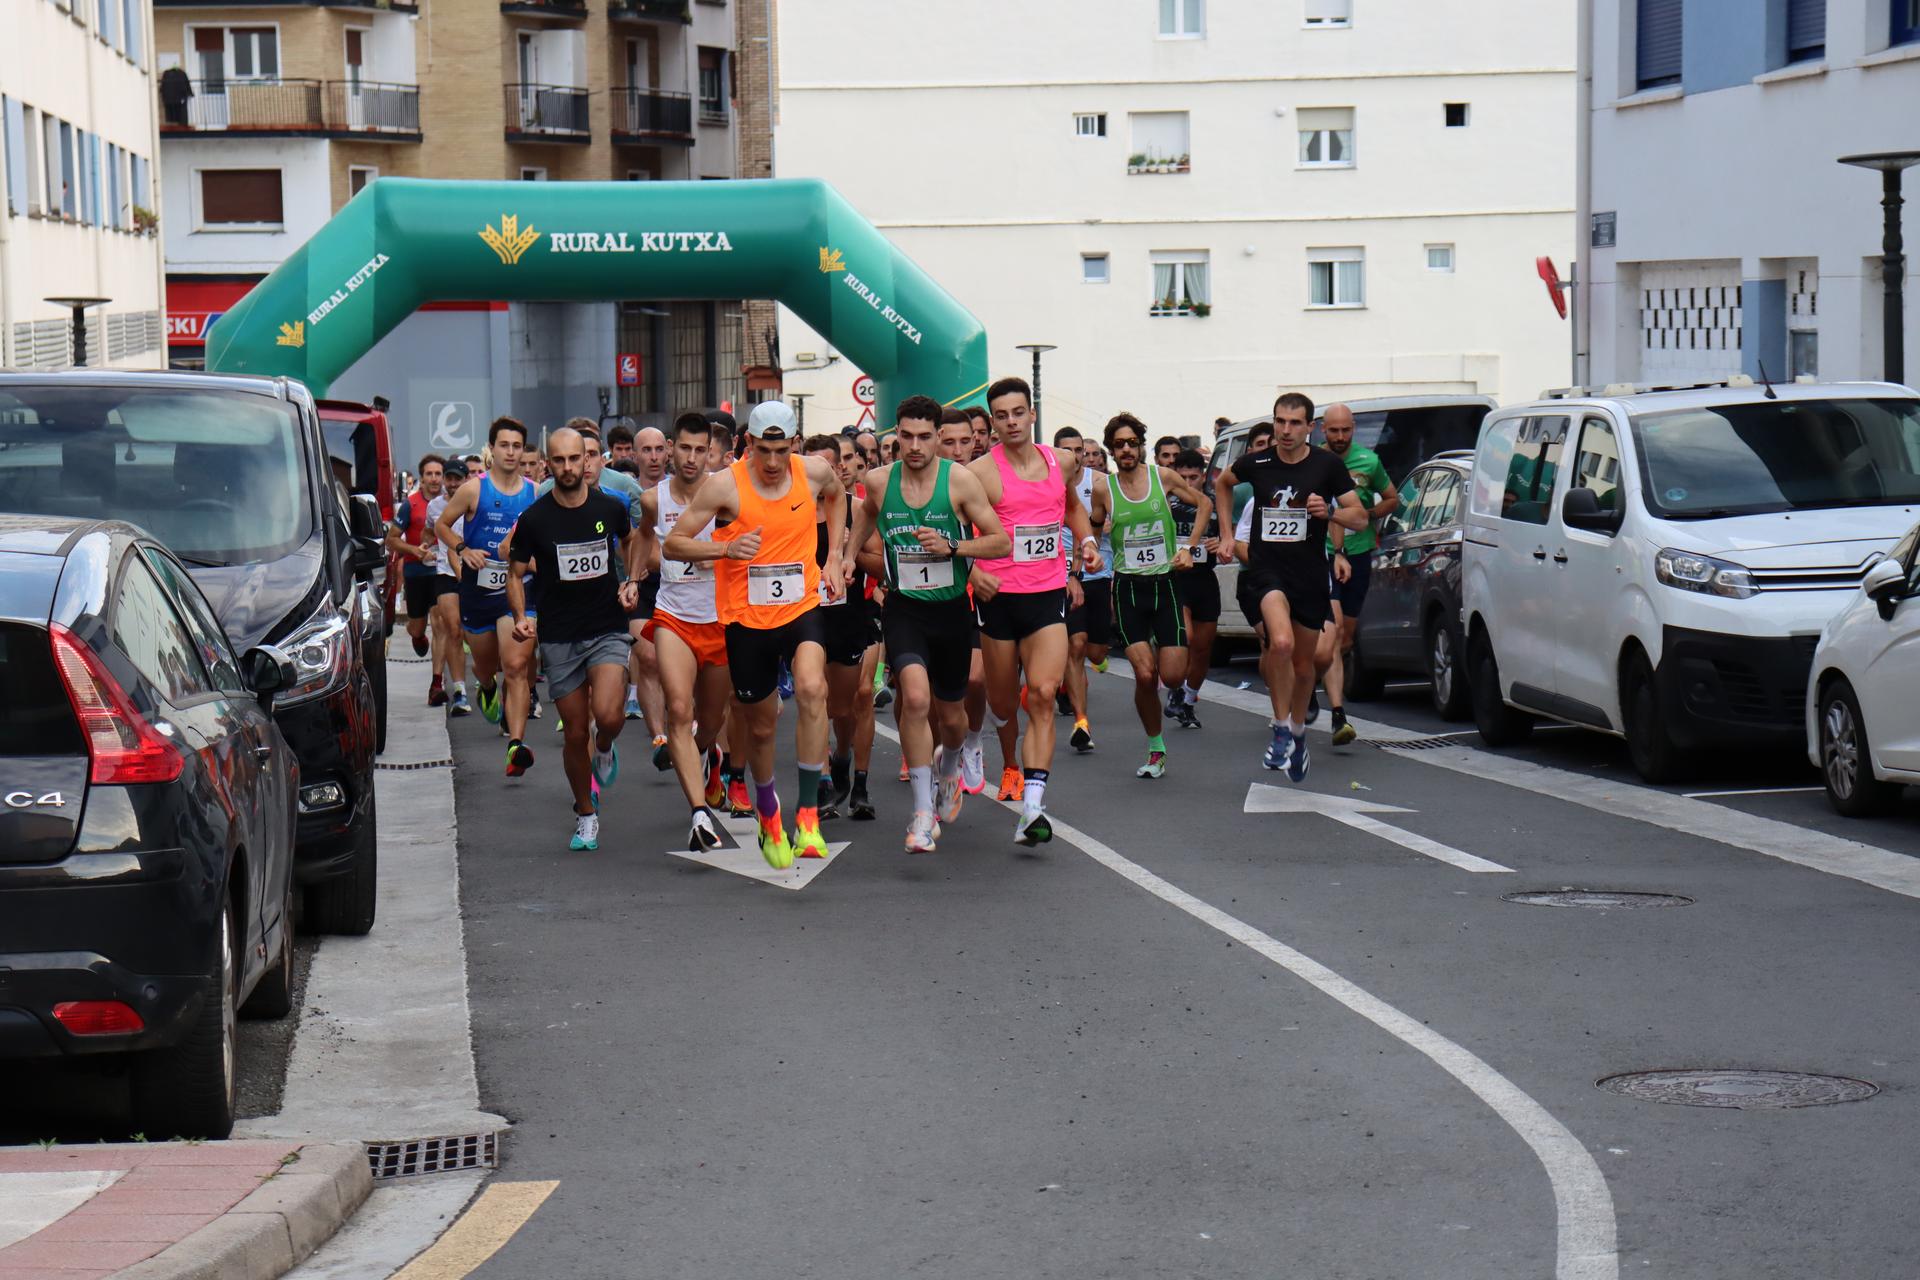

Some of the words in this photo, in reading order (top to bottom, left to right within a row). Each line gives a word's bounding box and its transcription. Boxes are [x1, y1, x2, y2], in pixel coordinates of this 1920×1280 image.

[550, 232, 635, 252] RURAL
[641, 231, 733, 251] KUTXA
[306, 289, 349, 326] RURAL
[345, 253, 390, 292] KUTXA
[843, 272, 881, 310] RURAL
[880, 305, 922, 345] KUTXA
[1123, 519, 1165, 540] LEA
[1268, 521, 1299, 536] 222
[1024, 536, 1055, 555] 128
[567, 555, 601, 574] 280
[1136, 548, 1156, 563] 45
[919, 566, 929, 583] 1
[771, 580, 784, 598] 3
[4, 791, 66, 808] C4
